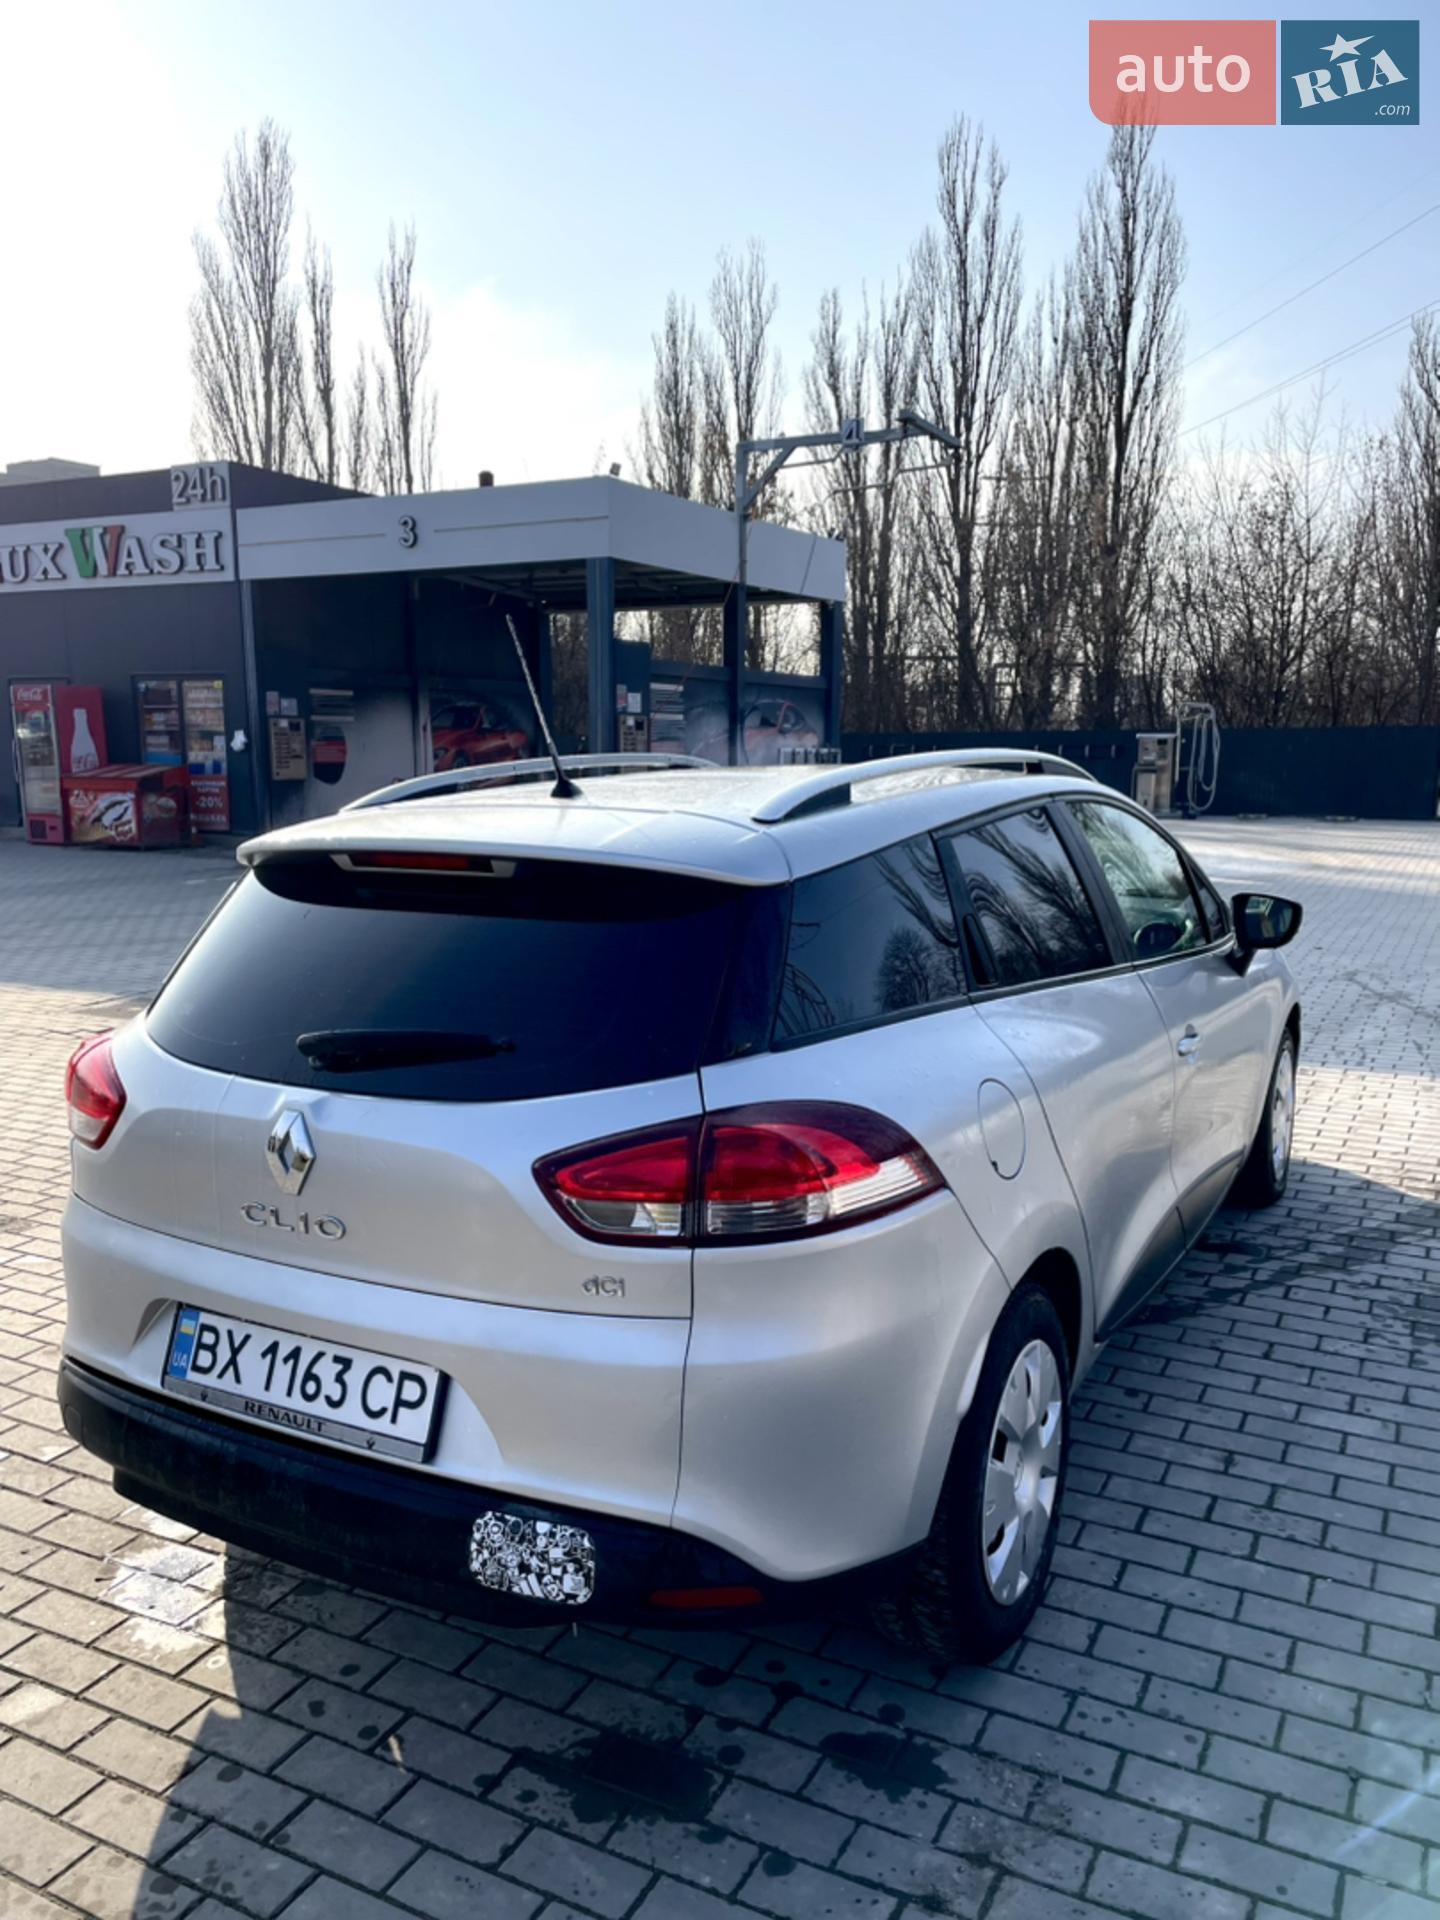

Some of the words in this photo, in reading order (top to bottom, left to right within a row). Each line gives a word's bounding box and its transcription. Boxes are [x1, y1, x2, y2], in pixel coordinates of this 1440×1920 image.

[171, 467, 227, 505] 24h
[399, 514, 418, 549] 3
[0, 542, 67, 583] UX
[241, 1201, 347, 1240] CLIO
[171, 1351, 190, 1369] UA
[190, 1323, 252, 1385] BX
[260, 1340, 353, 1410] 1163
[360, 1365, 428, 1425] CP
[243, 1400, 327, 1434] RENAULT
